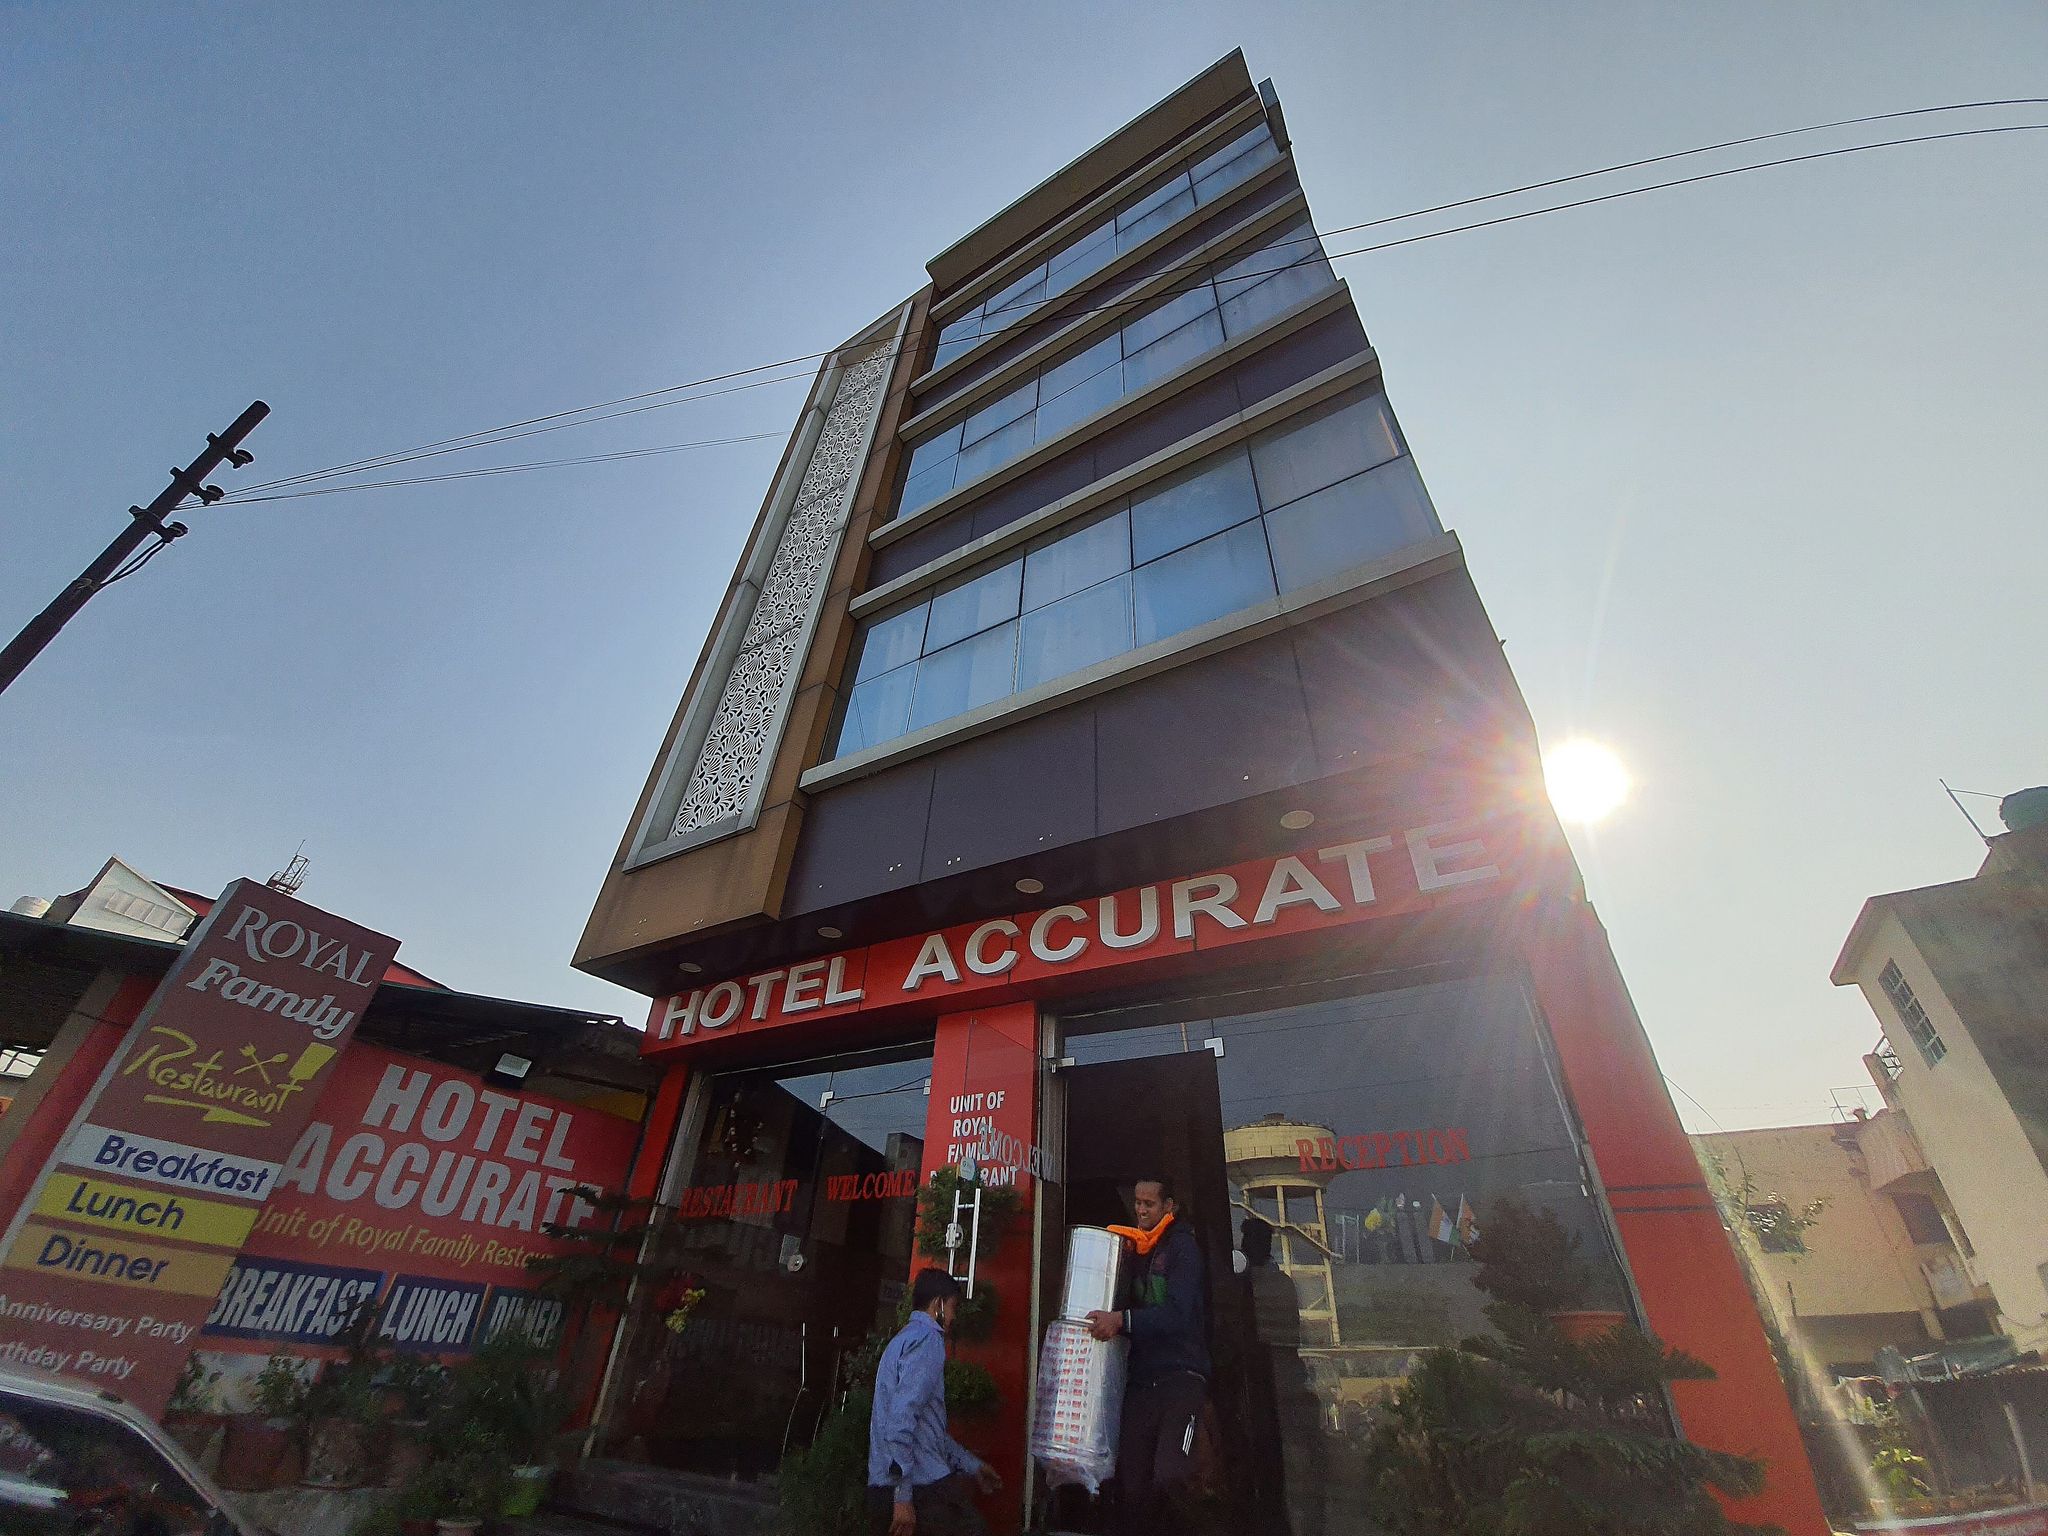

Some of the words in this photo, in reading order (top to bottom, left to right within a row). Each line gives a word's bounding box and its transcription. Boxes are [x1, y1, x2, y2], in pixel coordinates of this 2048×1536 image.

[224, 904, 375, 988] ROYAL
[658, 956, 866, 1041] HOTEL
[901, 823, 1502, 992] ACCURATE
[185, 957, 355, 1040] Family
[123, 1026, 304, 1113] Restaurant
[361, 1063, 576, 1172] HOTEL
[950, 1093, 984, 1114] UNIT
[987, 1090, 1006, 1109] OF
[953, 1116, 993, 1137] ROYAL
[94, 1134, 268, 1194] Breakfast
[1296, 1127, 1472, 1173] RECEPTION
[66, 1182, 185, 1230] Lunch
[272, 1121, 603, 1239] ACCURATE
[678, 1178, 800, 1219] RESTAURANT
[826, 1170, 916, 1200] WELCOME
[37, 1234, 169, 1283] Dinner
[309, 1213, 346, 1244] of
[340, 1219, 412, 1254] Royal
[409, 1226, 477, 1266] Family
[206, 1266, 377, 1336] BREAKFAST
[380, 1285, 479, 1344] LUNCH
[134, 1315, 196, 1345] Party
[74, 1350, 139, 1380] Party
